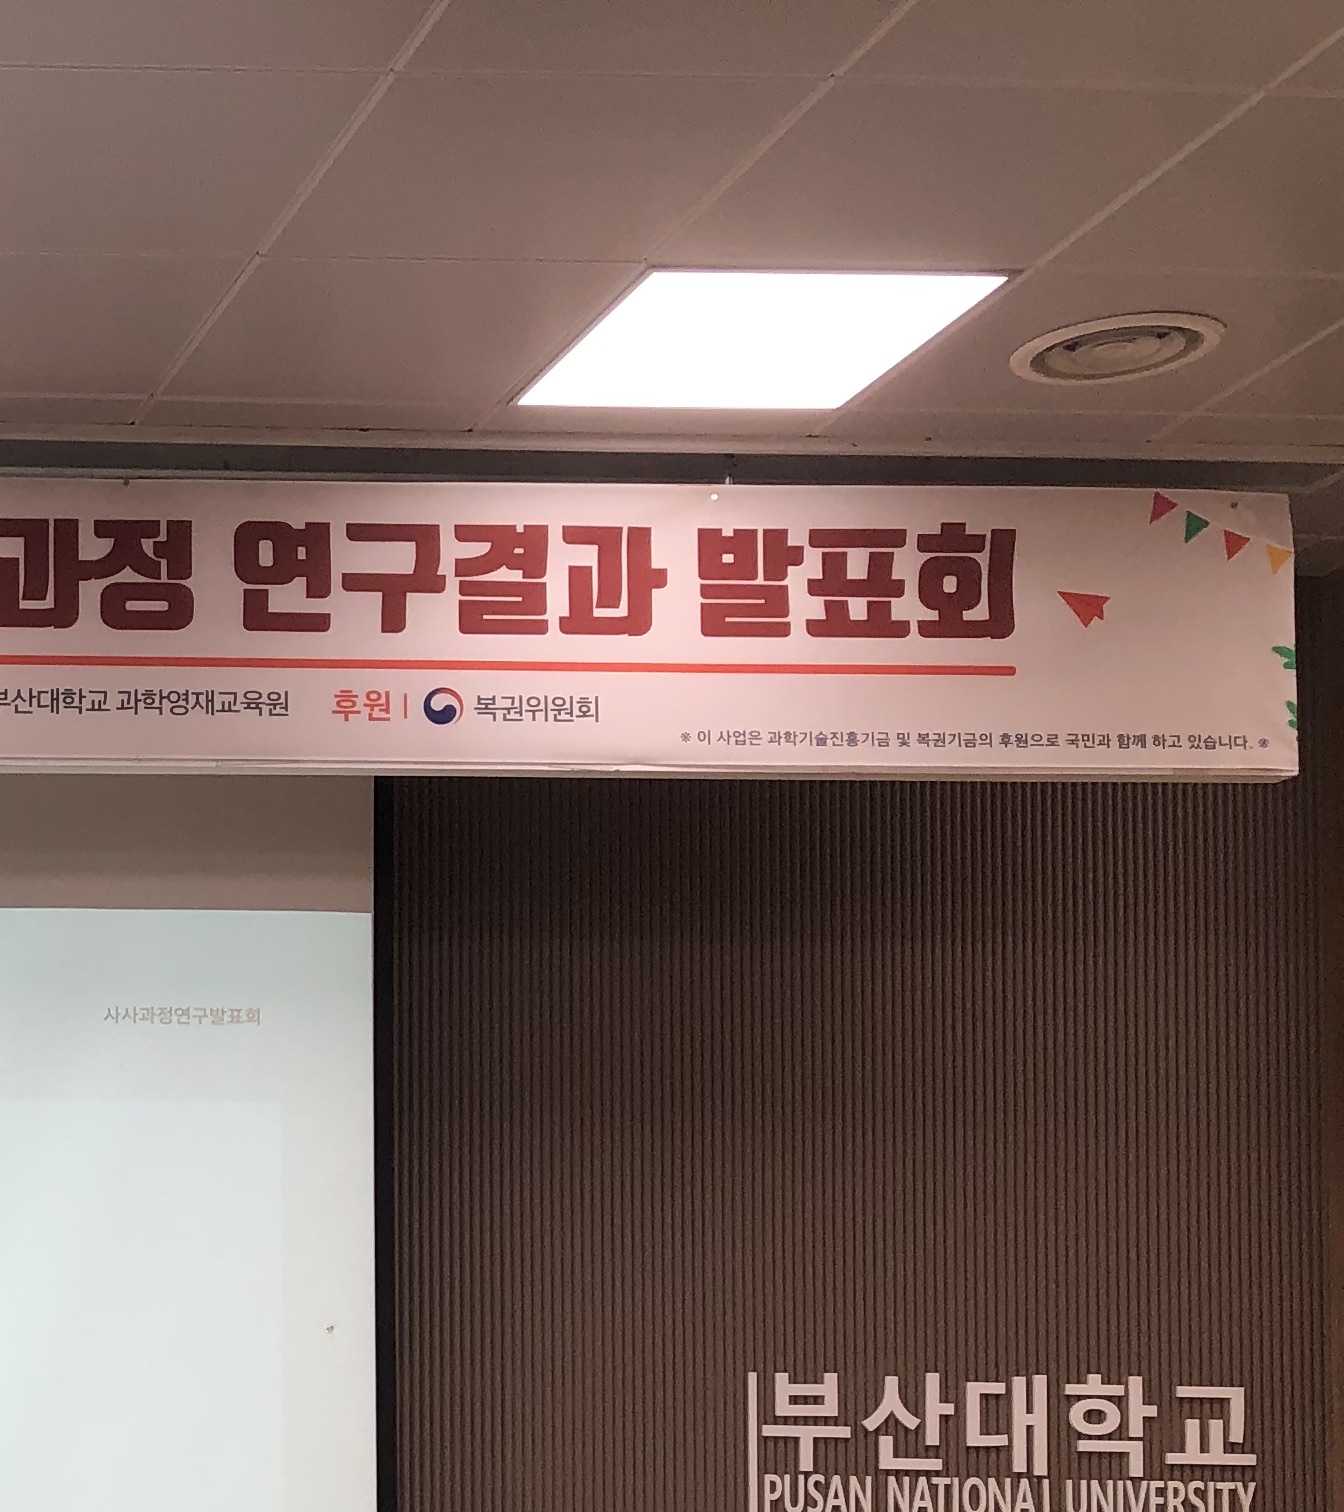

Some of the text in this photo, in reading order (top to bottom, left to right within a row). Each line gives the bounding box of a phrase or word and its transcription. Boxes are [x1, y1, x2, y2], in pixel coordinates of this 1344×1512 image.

[232, 519, 668, 637] 연구결과
[696, 521, 1017, 640] 발표회
[115, 688, 289, 717] 과학영재교육원
[331, 689, 391, 722] 후원
[473, 694, 600, 723] 복권위원회
[697, 729, 1253, 751] 이 사업은 과학기술진흥기금 및 복권기금의 후원으로 국민과 함께 하고 있습니다.
[103, 1005, 261, 1026] 사사과정연구발표회
[760, 1372, 1257, 1477] 부산대학교
